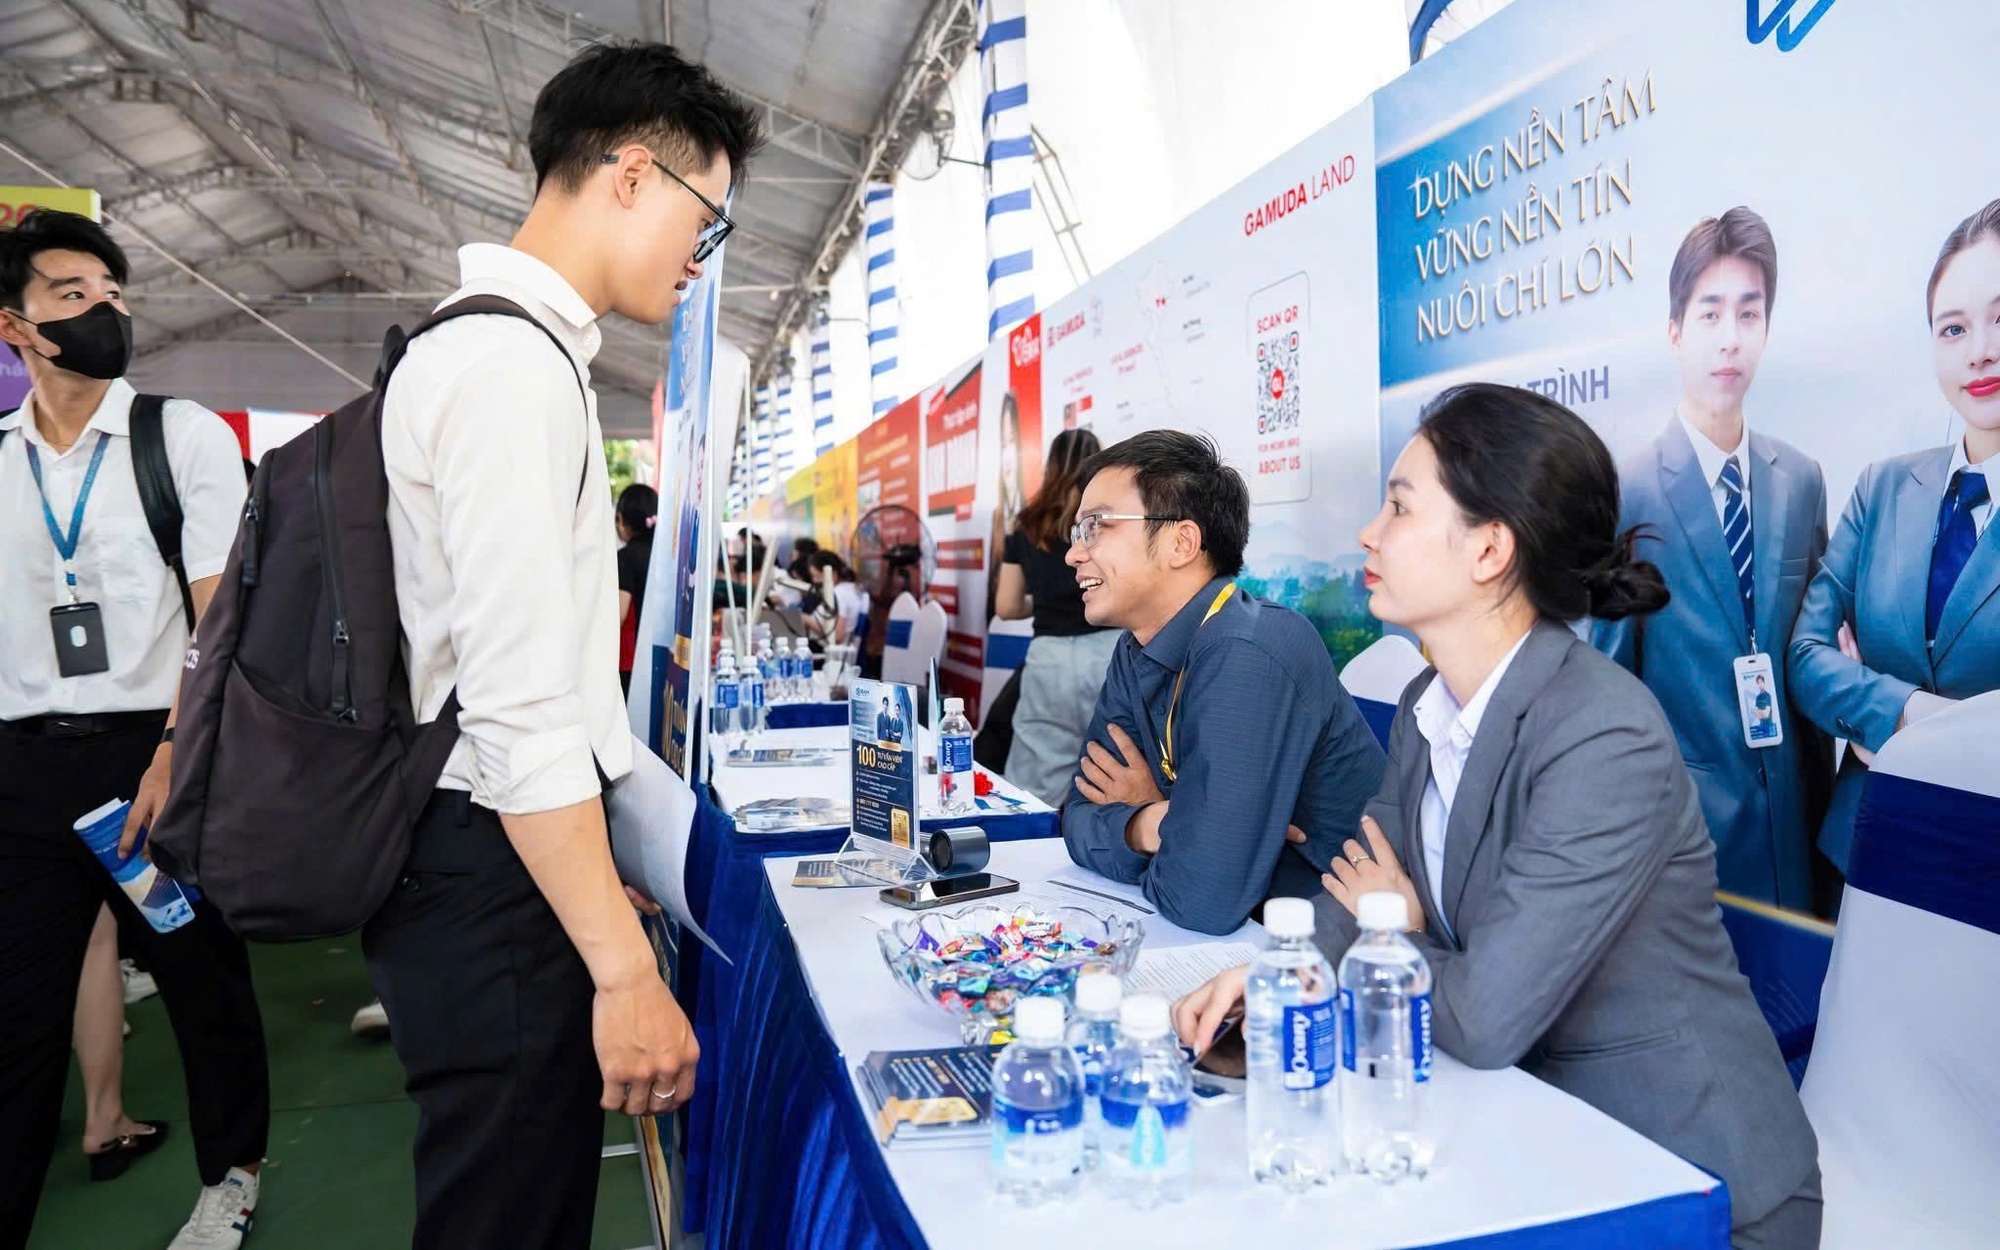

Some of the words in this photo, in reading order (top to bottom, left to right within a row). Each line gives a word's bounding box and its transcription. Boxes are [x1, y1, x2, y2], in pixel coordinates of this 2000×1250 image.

[1574, 65, 1657, 144] TÂM
[1243, 182, 1308, 237] GAMUDA
[1312, 154, 1356, 201] LAND
[1415, 215, 1493, 281] VỮNG
[1572, 155, 1633, 222] TÍN
[1257, 313, 1282, 334] SCAN
[1284, 305, 1299, 323] QR
[1416, 278, 1487, 343] NUÔI
[1494, 255, 1549, 318] CHÍ
[1559, 232, 1635, 301] LỚN
[1258, 457, 1287, 474] ABOUT
[1289, 455, 1301, 470] US
[856, 744, 877, 768] 100
[1290, 1010, 1312, 1074] Ocany
